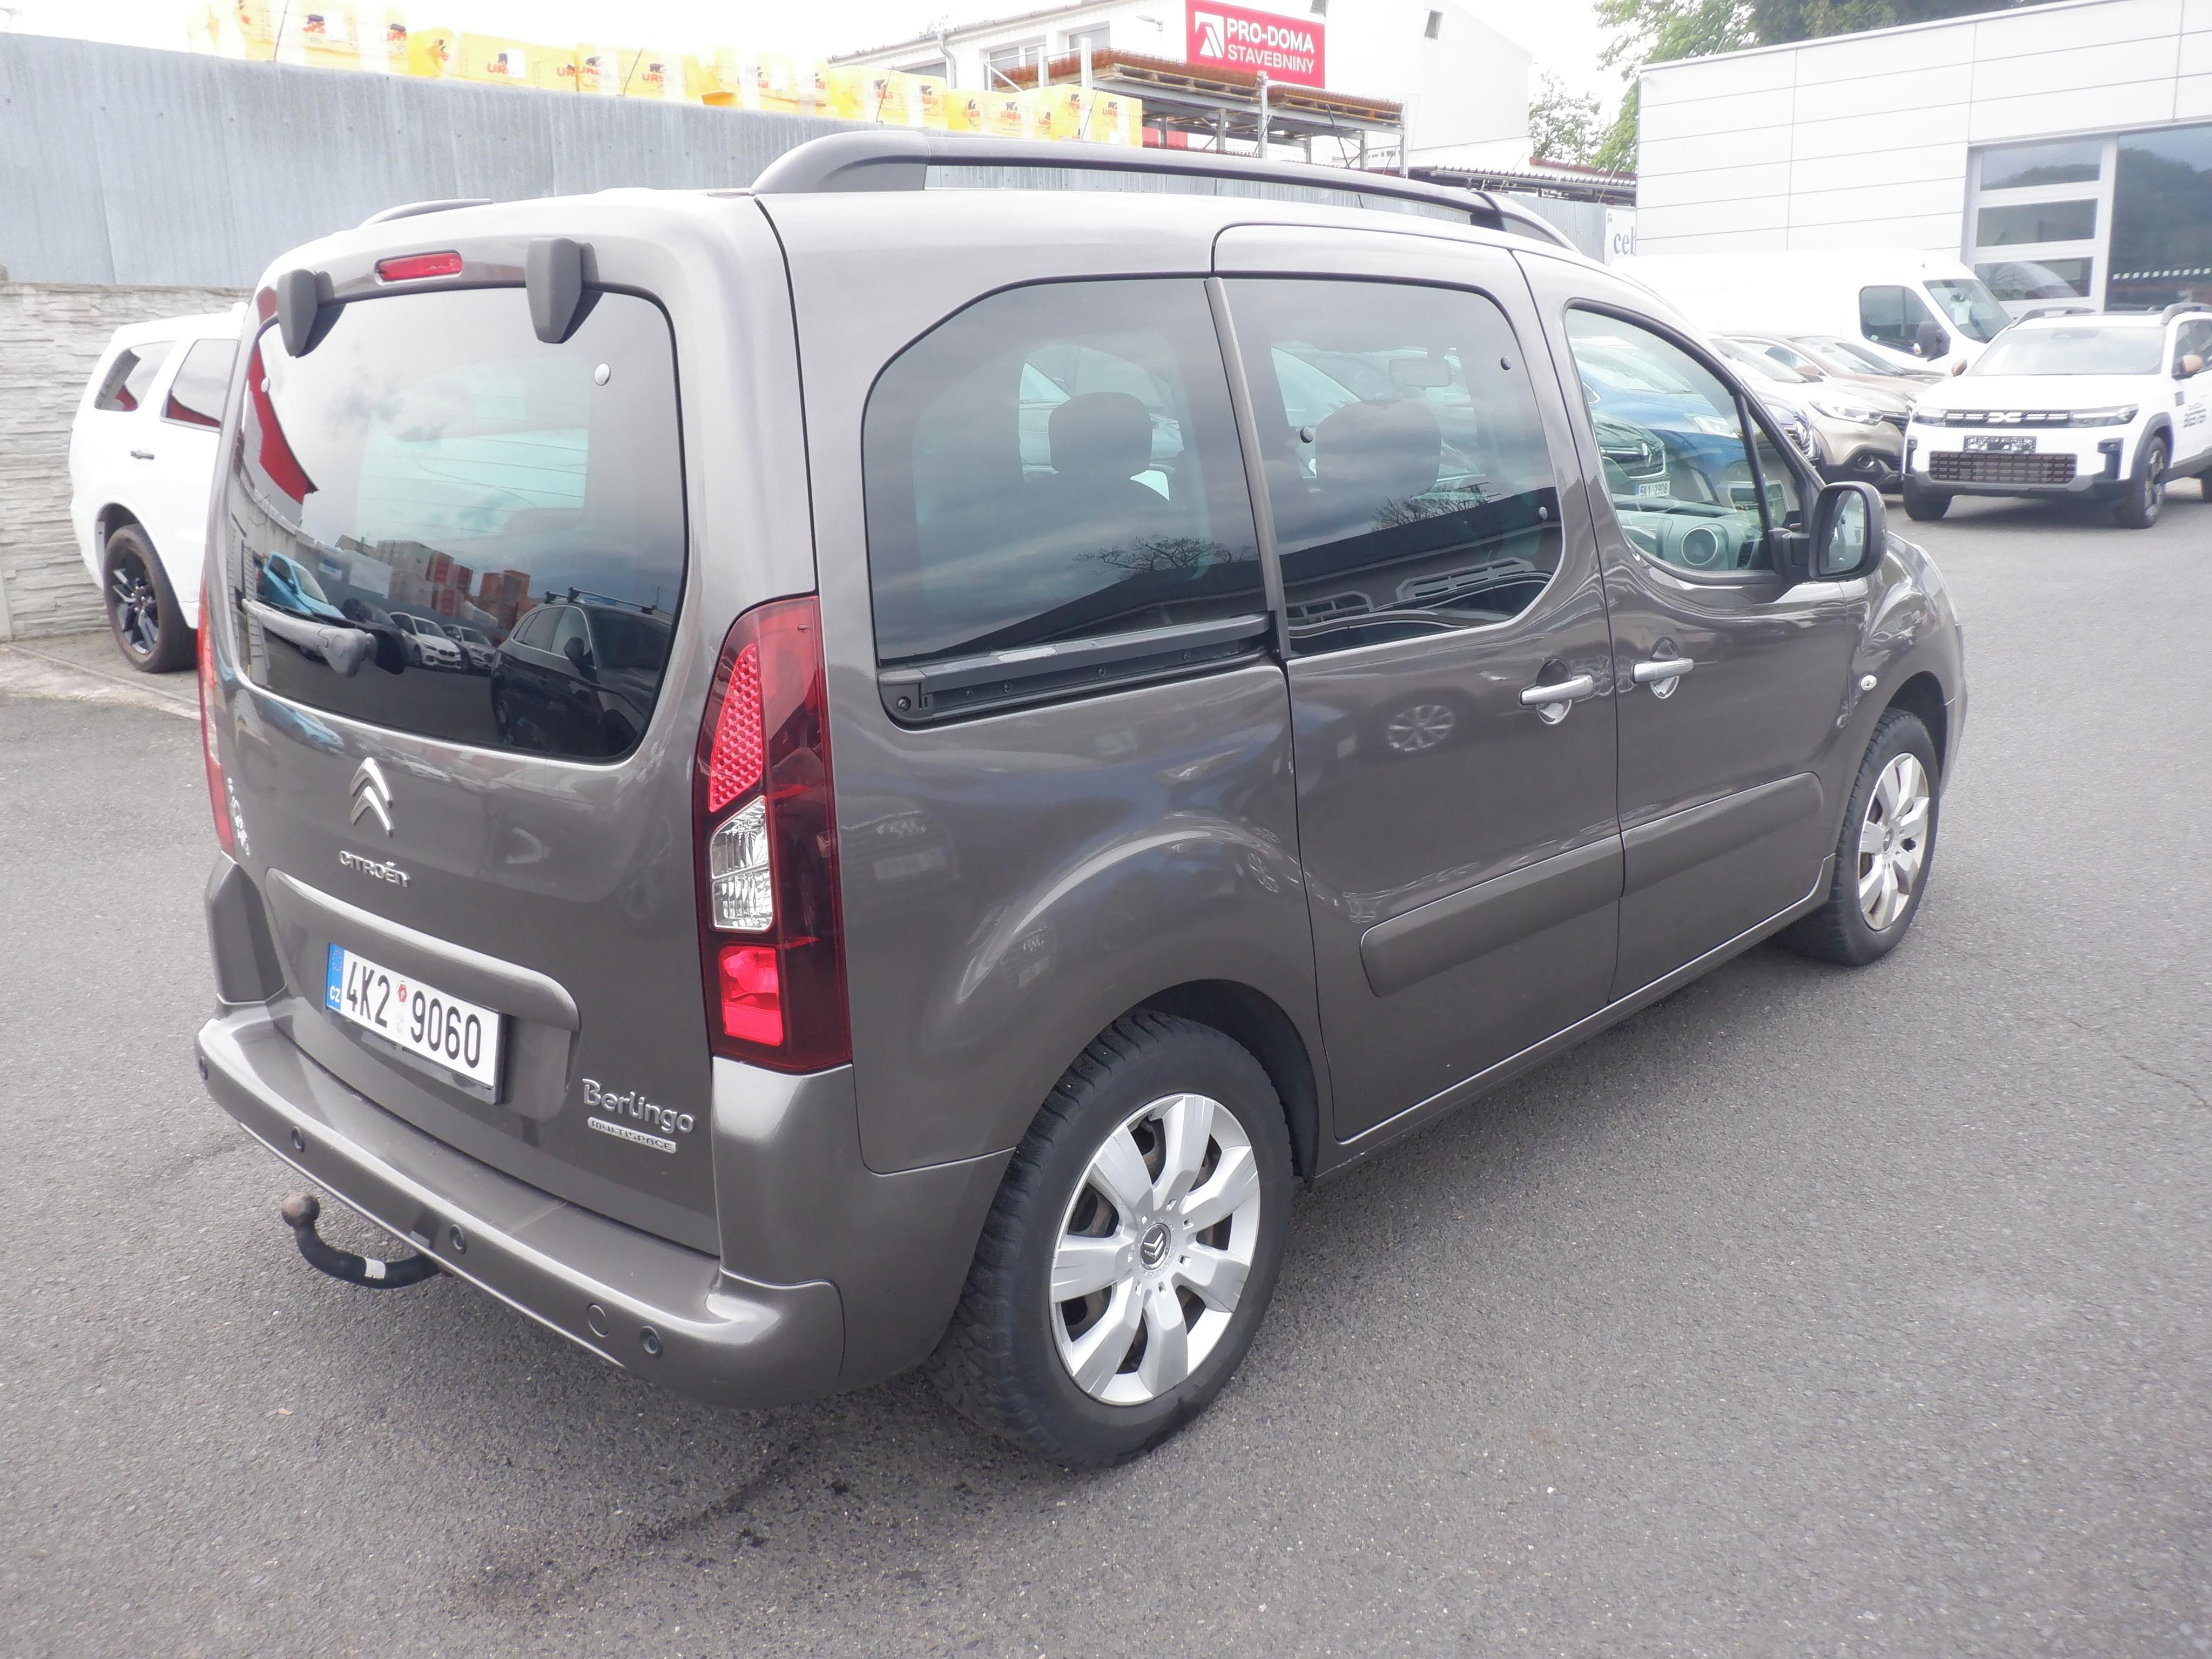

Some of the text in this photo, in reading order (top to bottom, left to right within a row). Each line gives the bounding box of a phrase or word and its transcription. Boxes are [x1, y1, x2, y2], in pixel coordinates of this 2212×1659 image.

[1226, 17, 1315, 54] PRO-DOMA
[1227, 44, 1315, 74] STAVEBNINY
[338, 850, 412, 887] CITROËN
[329, 985, 341, 1003] CZ
[346, 961, 481, 1069] 4K2 9060
[582, 1078, 695, 1134] Berlingo
[591, 1120, 673, 1151] MULTISPACE
